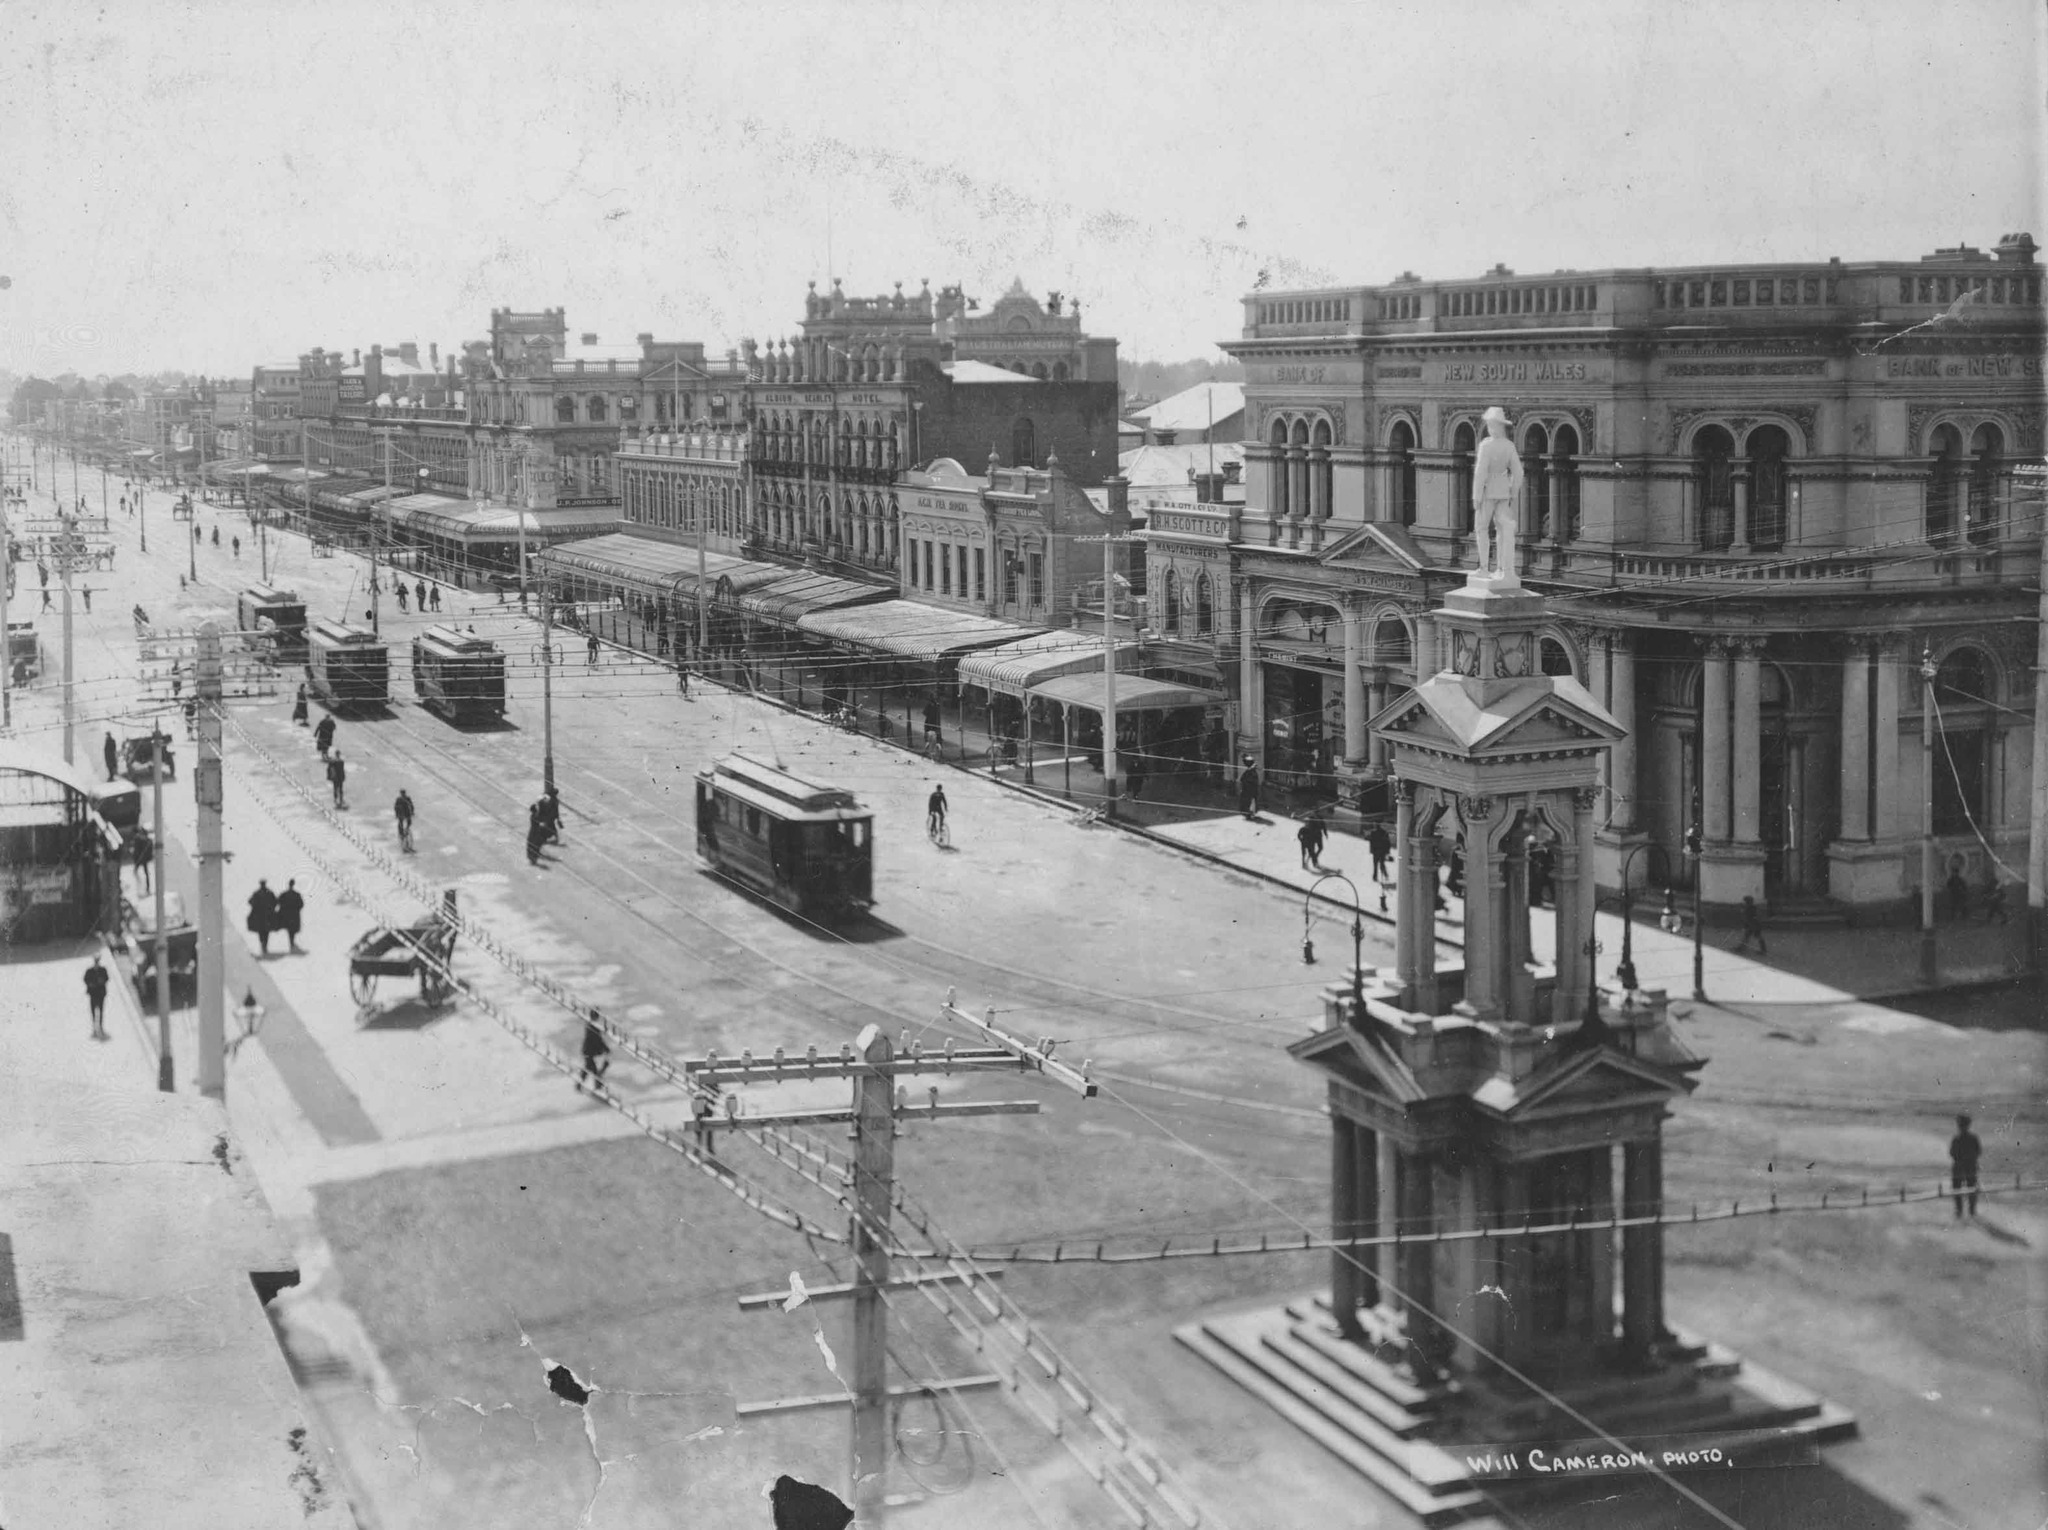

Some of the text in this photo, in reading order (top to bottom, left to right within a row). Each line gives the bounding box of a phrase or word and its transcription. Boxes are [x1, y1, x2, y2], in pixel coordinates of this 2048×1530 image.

[1277, 362, 1586, 383] BANK OF NEW SOUTH WALES
[1887, 357, 1942, 378] BANK
[1946, 364, 1965, 377] OF
[1968, 357, 2011, 378] NEW
[1172, 516, 1204, 533] SCOTT
[1155, 542, 1219, 560] MANUFACTURERS
